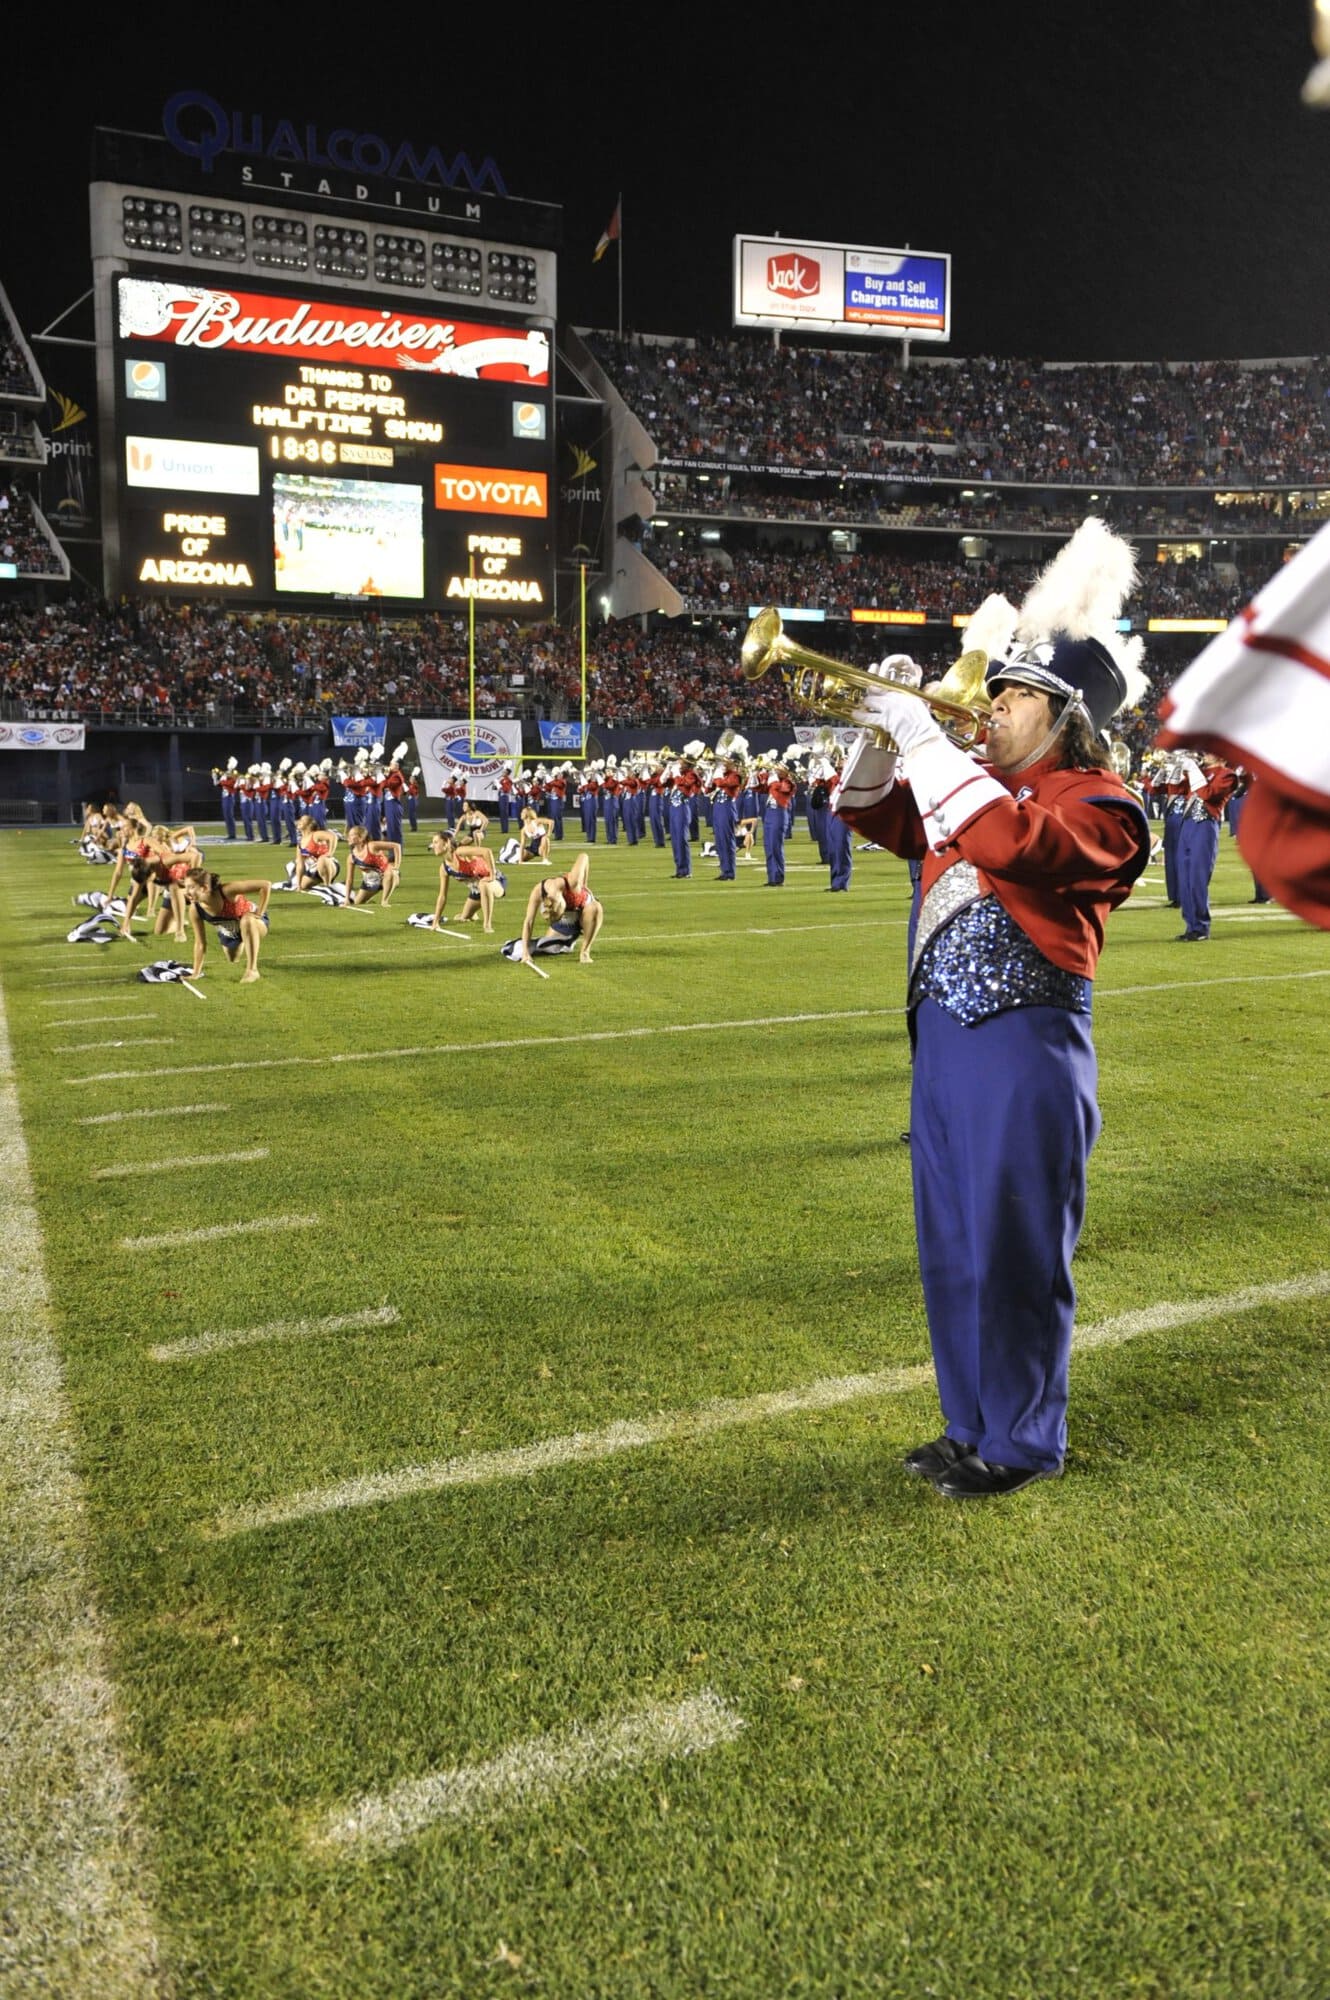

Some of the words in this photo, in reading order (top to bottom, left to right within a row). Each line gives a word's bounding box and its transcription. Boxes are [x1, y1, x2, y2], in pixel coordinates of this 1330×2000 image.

[162, 91, 508, 197] QUALCOMM
[242, 166, 481, 218] STADIUM
[768, 258, 818, 293] Jack
[865, 276, 884, 292] Buy
[886, 280, 904, 292] and
[907, 280, 926, 293] Sell
[851, 290, 898, 307] Chargers
[899, 294, 939, 310] Tickets!
[165, 292, 455, 351] Budweiser
[300, 366, 364, 391] THANKS
[369, 373, 392, 392] TO
[285, 386, 317, 405] DR
[325, 390, 406, 416] PEPPER
[253, 406, 372, 437] HALFTIME
[385, 413, 443, 442] SHOW
[162, 457, 214, 475] Union
[750, 465, 765, 473] TEXT
[441, 477, 542, 507] TOYOTA
[560, 485, 600, 503] Sprint
[164, 513, 226, 535] PRIDE
[181, 538, 209, 556] OF
[468, 535, 521, 556] PRIDE
[140, 559, 252, 587] ARIZONA
[483, 557, 507, 575] OF
[447, 577, 543, 602] ARIZONA
[477, 728, 497, 744] LIFE
